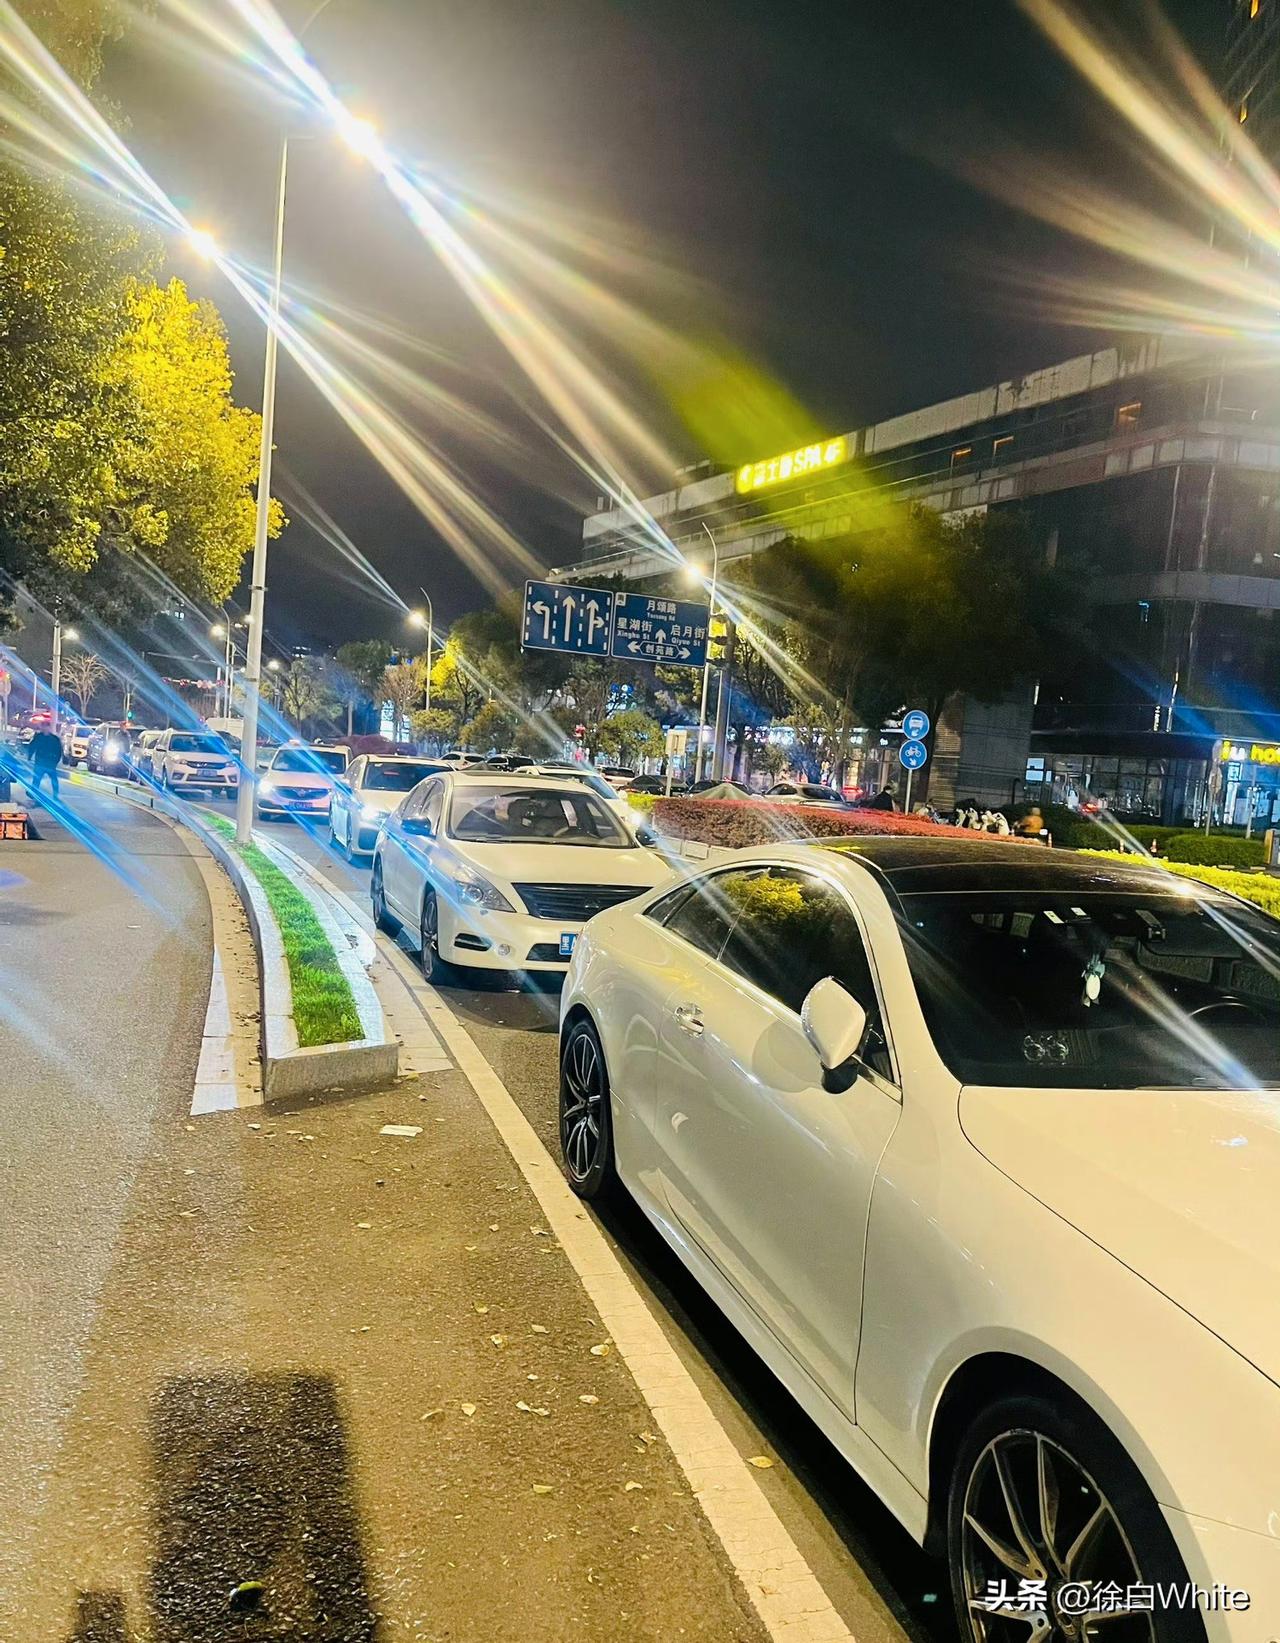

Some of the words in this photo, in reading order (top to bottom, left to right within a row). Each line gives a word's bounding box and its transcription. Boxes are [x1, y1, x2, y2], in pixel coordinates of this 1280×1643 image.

[617, 617, 653, 633] 星湖街
[642, 633, 650, 641] St
[670, 624, 706, 640] 启月街
[671, 637, 691, 646] Qiyue
[693, 639, 701, 647] St
[645, 644, 674, 656] 创苑路
